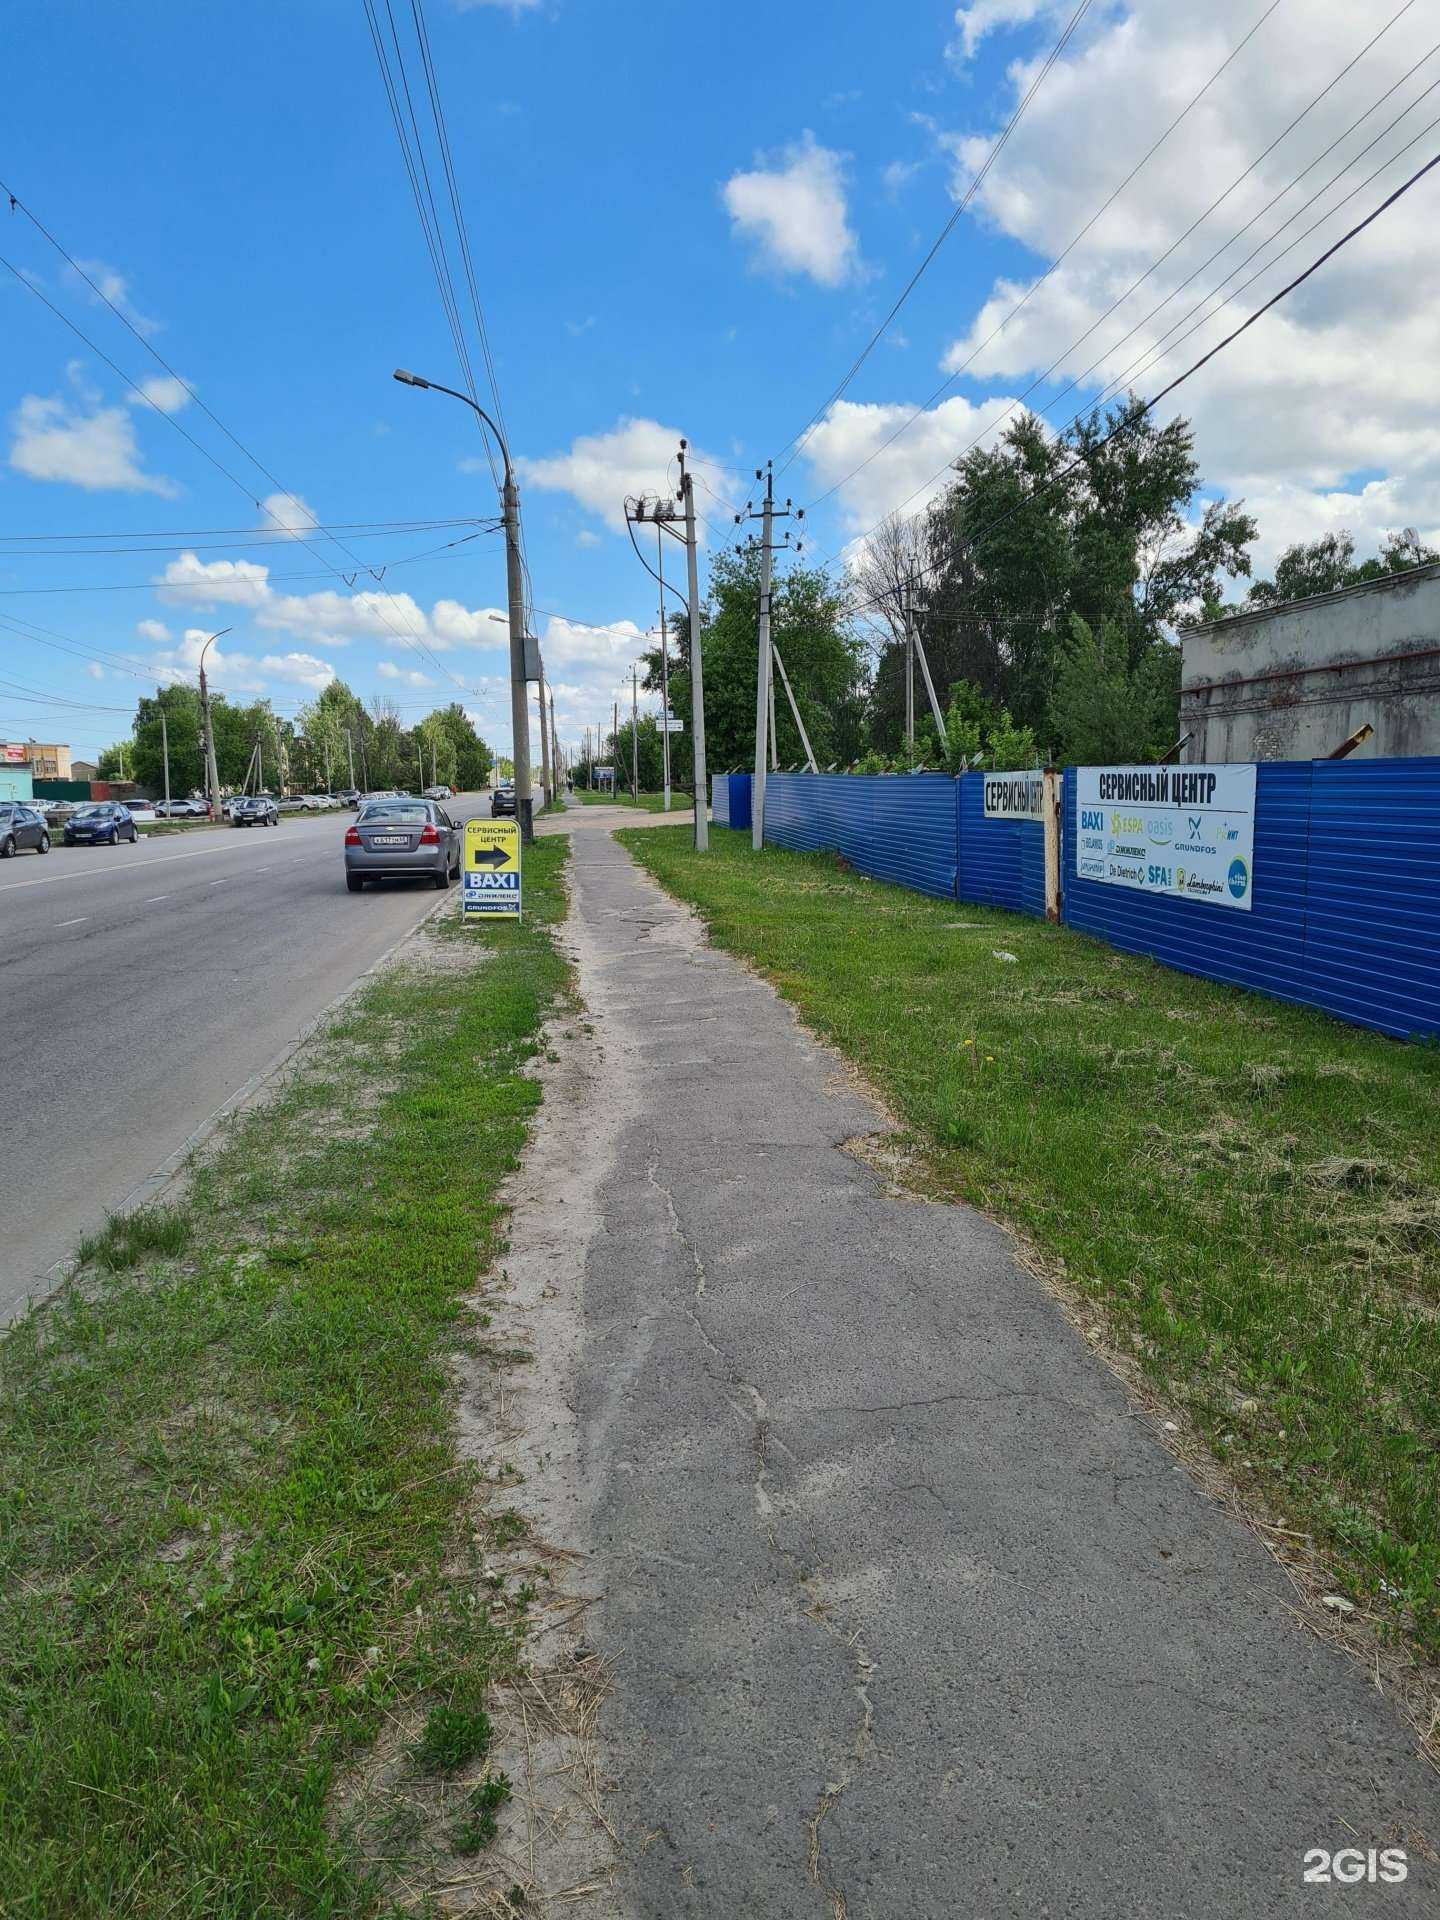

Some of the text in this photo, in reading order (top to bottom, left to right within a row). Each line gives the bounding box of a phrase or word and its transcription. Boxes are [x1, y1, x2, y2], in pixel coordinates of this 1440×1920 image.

[1099, 768, 1217, 808] СЕРВИСНЫЙ ЦЕНТР
[1081, 811, 1104, 831] BAXI
[1122, 817, 1143, 834] ESPA
[1147, 817, 1173, 836] oasis
[467, 826, 517, 834] СЕРВИСНЫЙ
[480, 835, 507, 843] ЦЕНТР
[1174, 843, 1217, 855] GRUNDFOS
[469, 873, 515, 888] BAXI
[1109, 864, 1117, 876] De
[1117, 865, 1137, 880] Dietrich
[1148, 865, 1168, 886] SFA
[1186, 873, 1225, 894] Lamborghini
